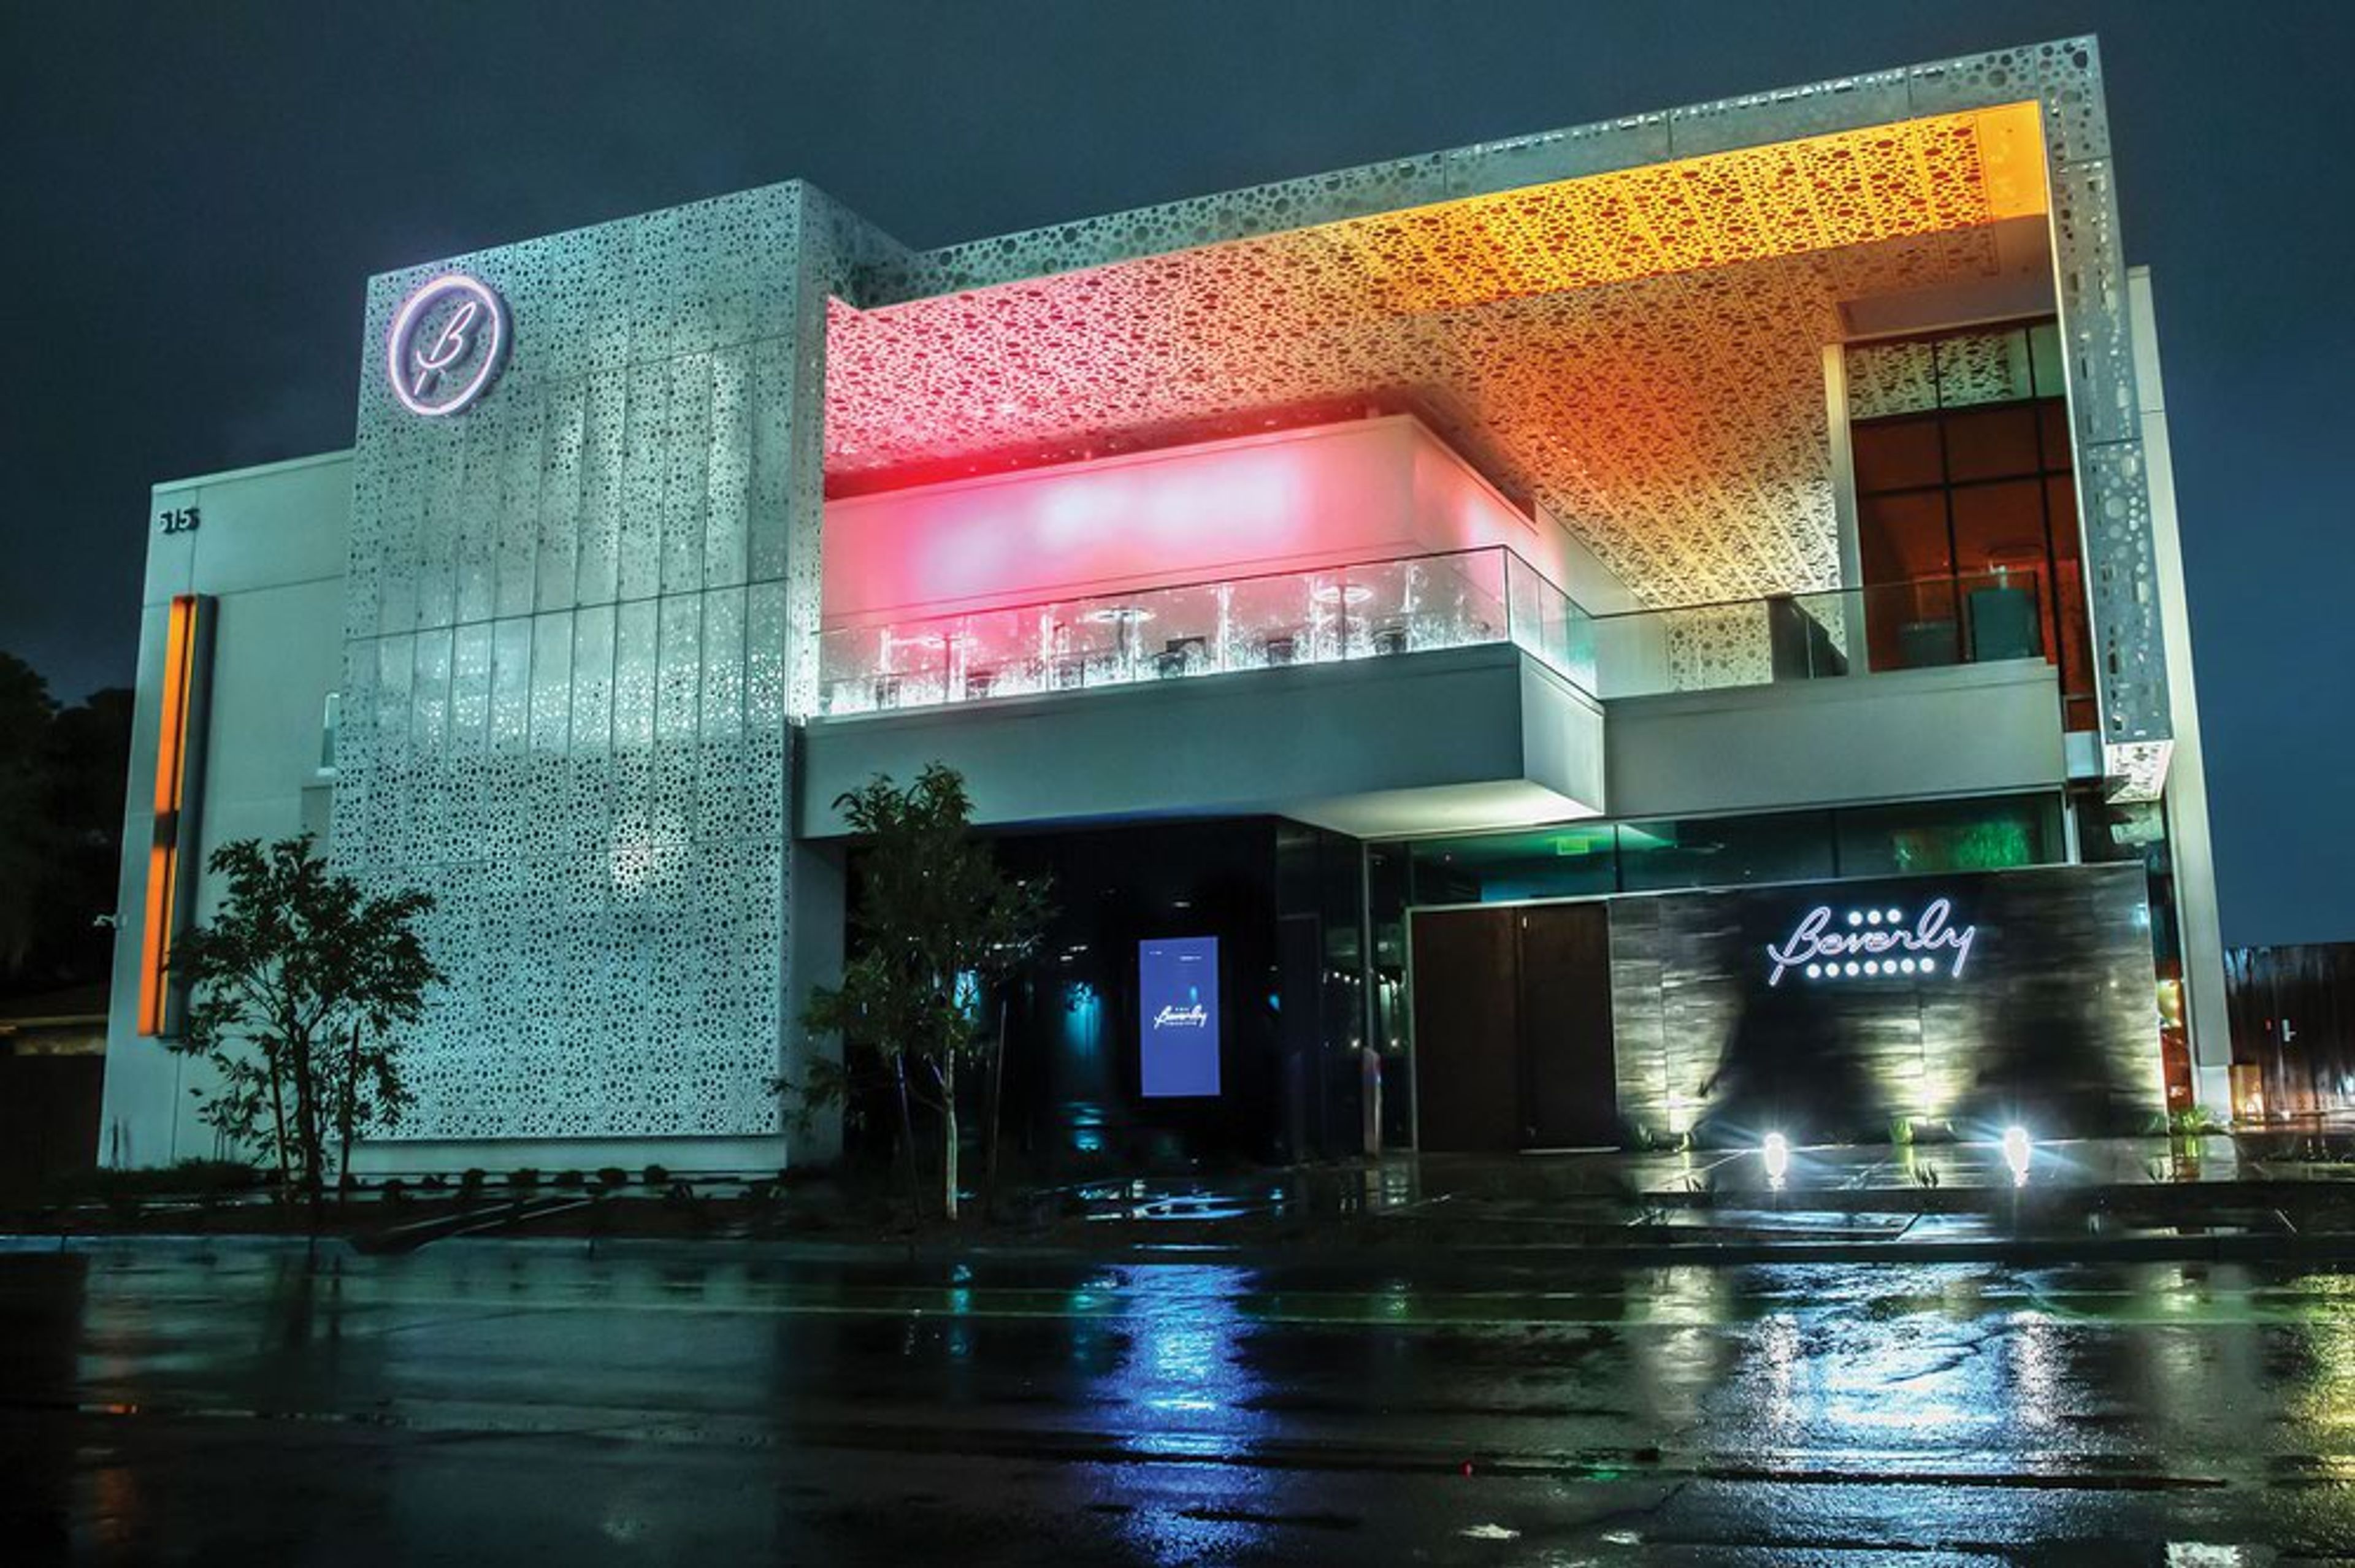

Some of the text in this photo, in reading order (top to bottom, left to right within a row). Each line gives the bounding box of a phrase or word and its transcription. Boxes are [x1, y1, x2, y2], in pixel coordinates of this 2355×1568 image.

[414, 301, 477, 396] B
[1766, 898, 1976, 987] Beverly
[1154, 1004, 1207, 1030] Brly
